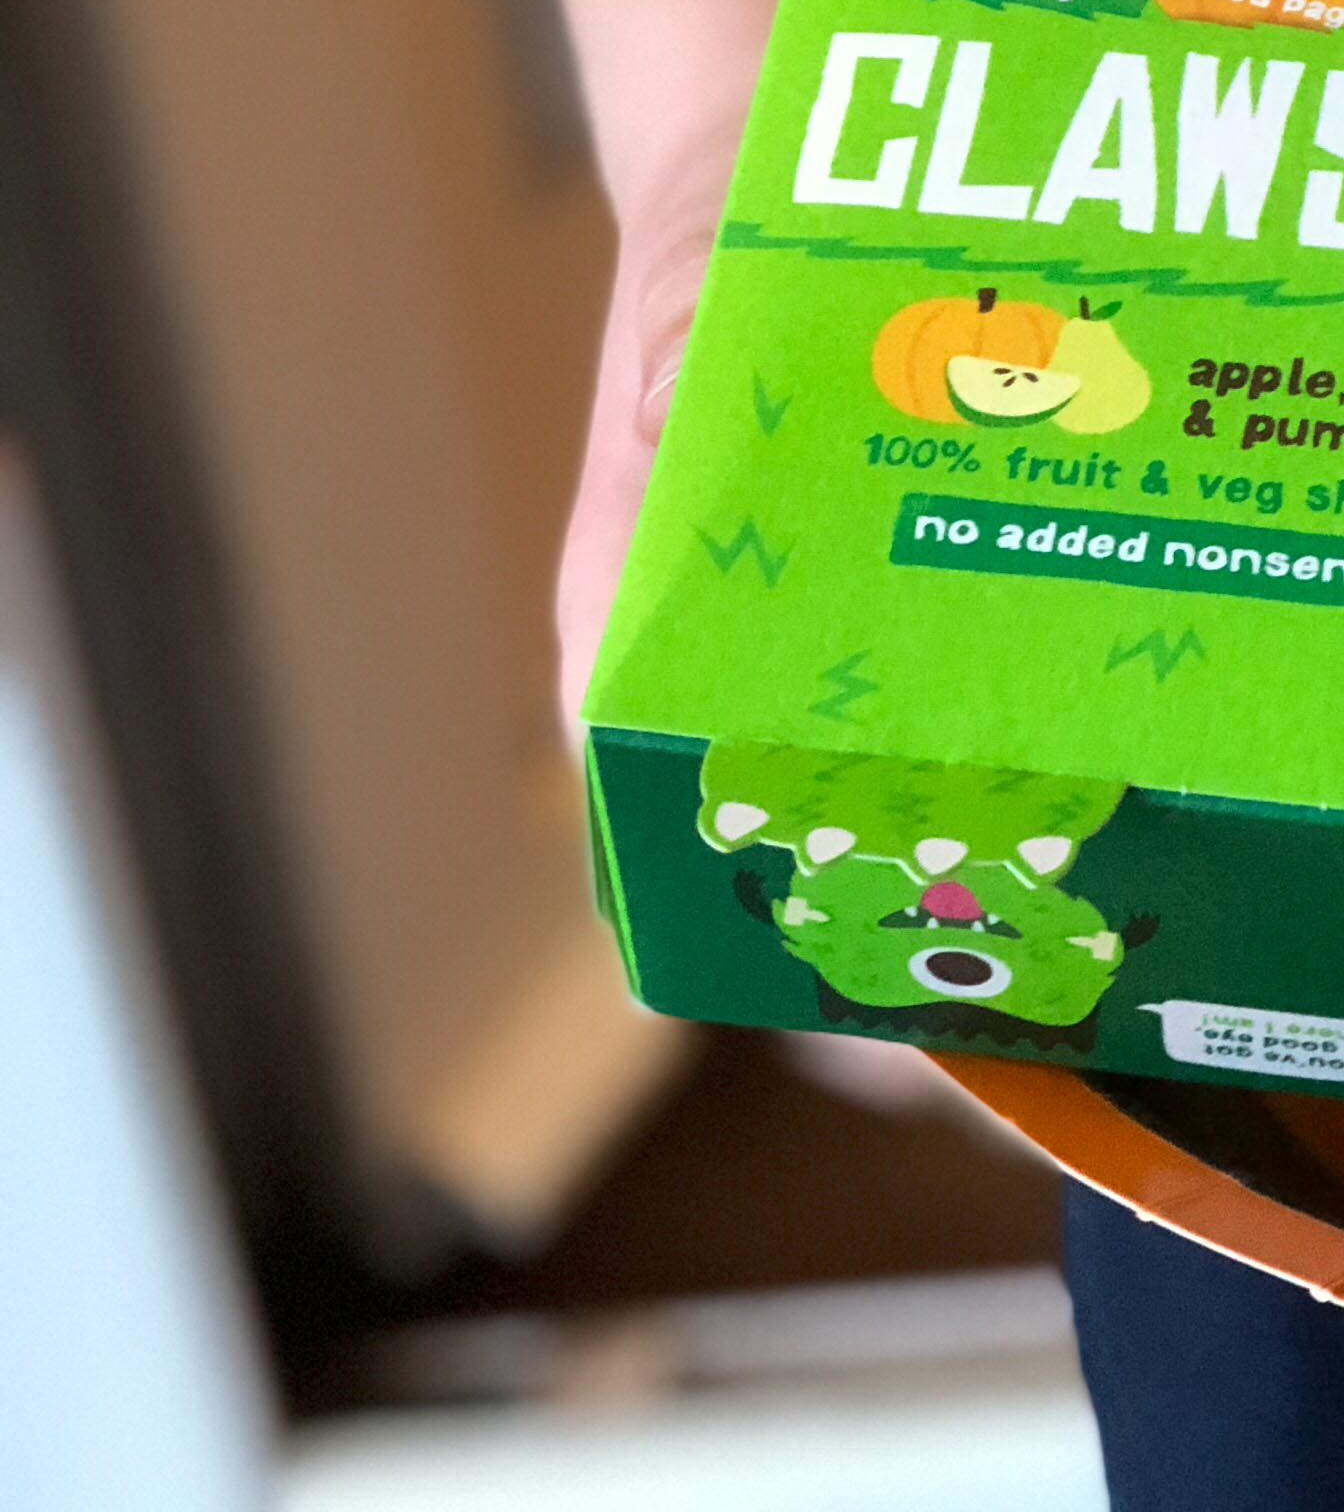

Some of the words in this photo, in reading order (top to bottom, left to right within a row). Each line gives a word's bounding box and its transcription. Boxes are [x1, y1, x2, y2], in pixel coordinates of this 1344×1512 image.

[1181, 399, 1217, 439] &
[863, 431, 983, 475] 100%
[1005, 444, 1122, 490] fruit
[1139, 460, 1171, 497] &
[1196, 472, 1284, 515] veg
[913, 511, 981, 546] no
[995, 520, 1151, 564] added
[1203, 1044, 1253, 1059] got
[1262, 1037, 1339, 1054] good
